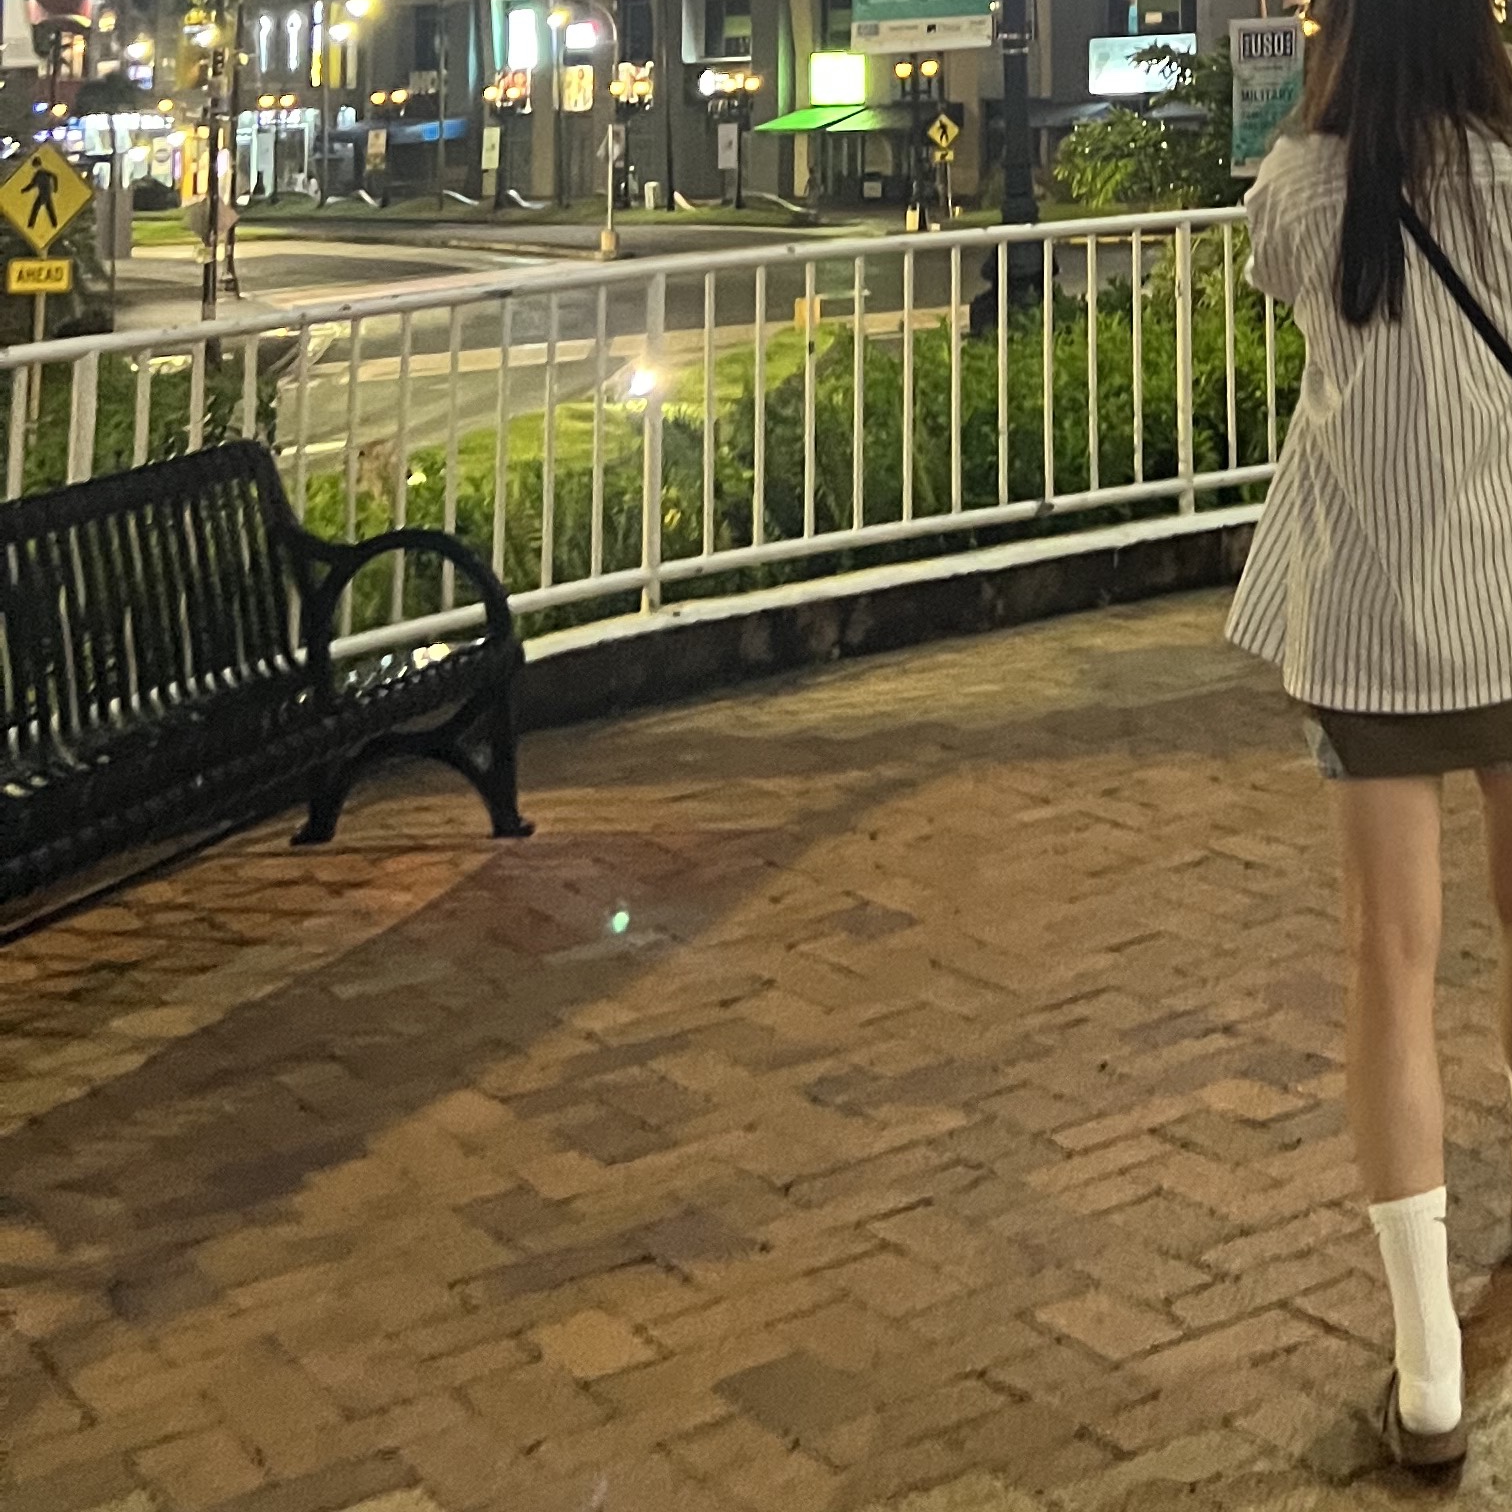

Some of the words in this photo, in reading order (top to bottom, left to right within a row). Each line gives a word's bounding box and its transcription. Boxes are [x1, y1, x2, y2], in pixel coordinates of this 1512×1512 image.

[1251, 32, 1284, 57] USO
[1241, 90, 1294, 103] MILITARY
[17, 266, 64, 283] AHEAD
